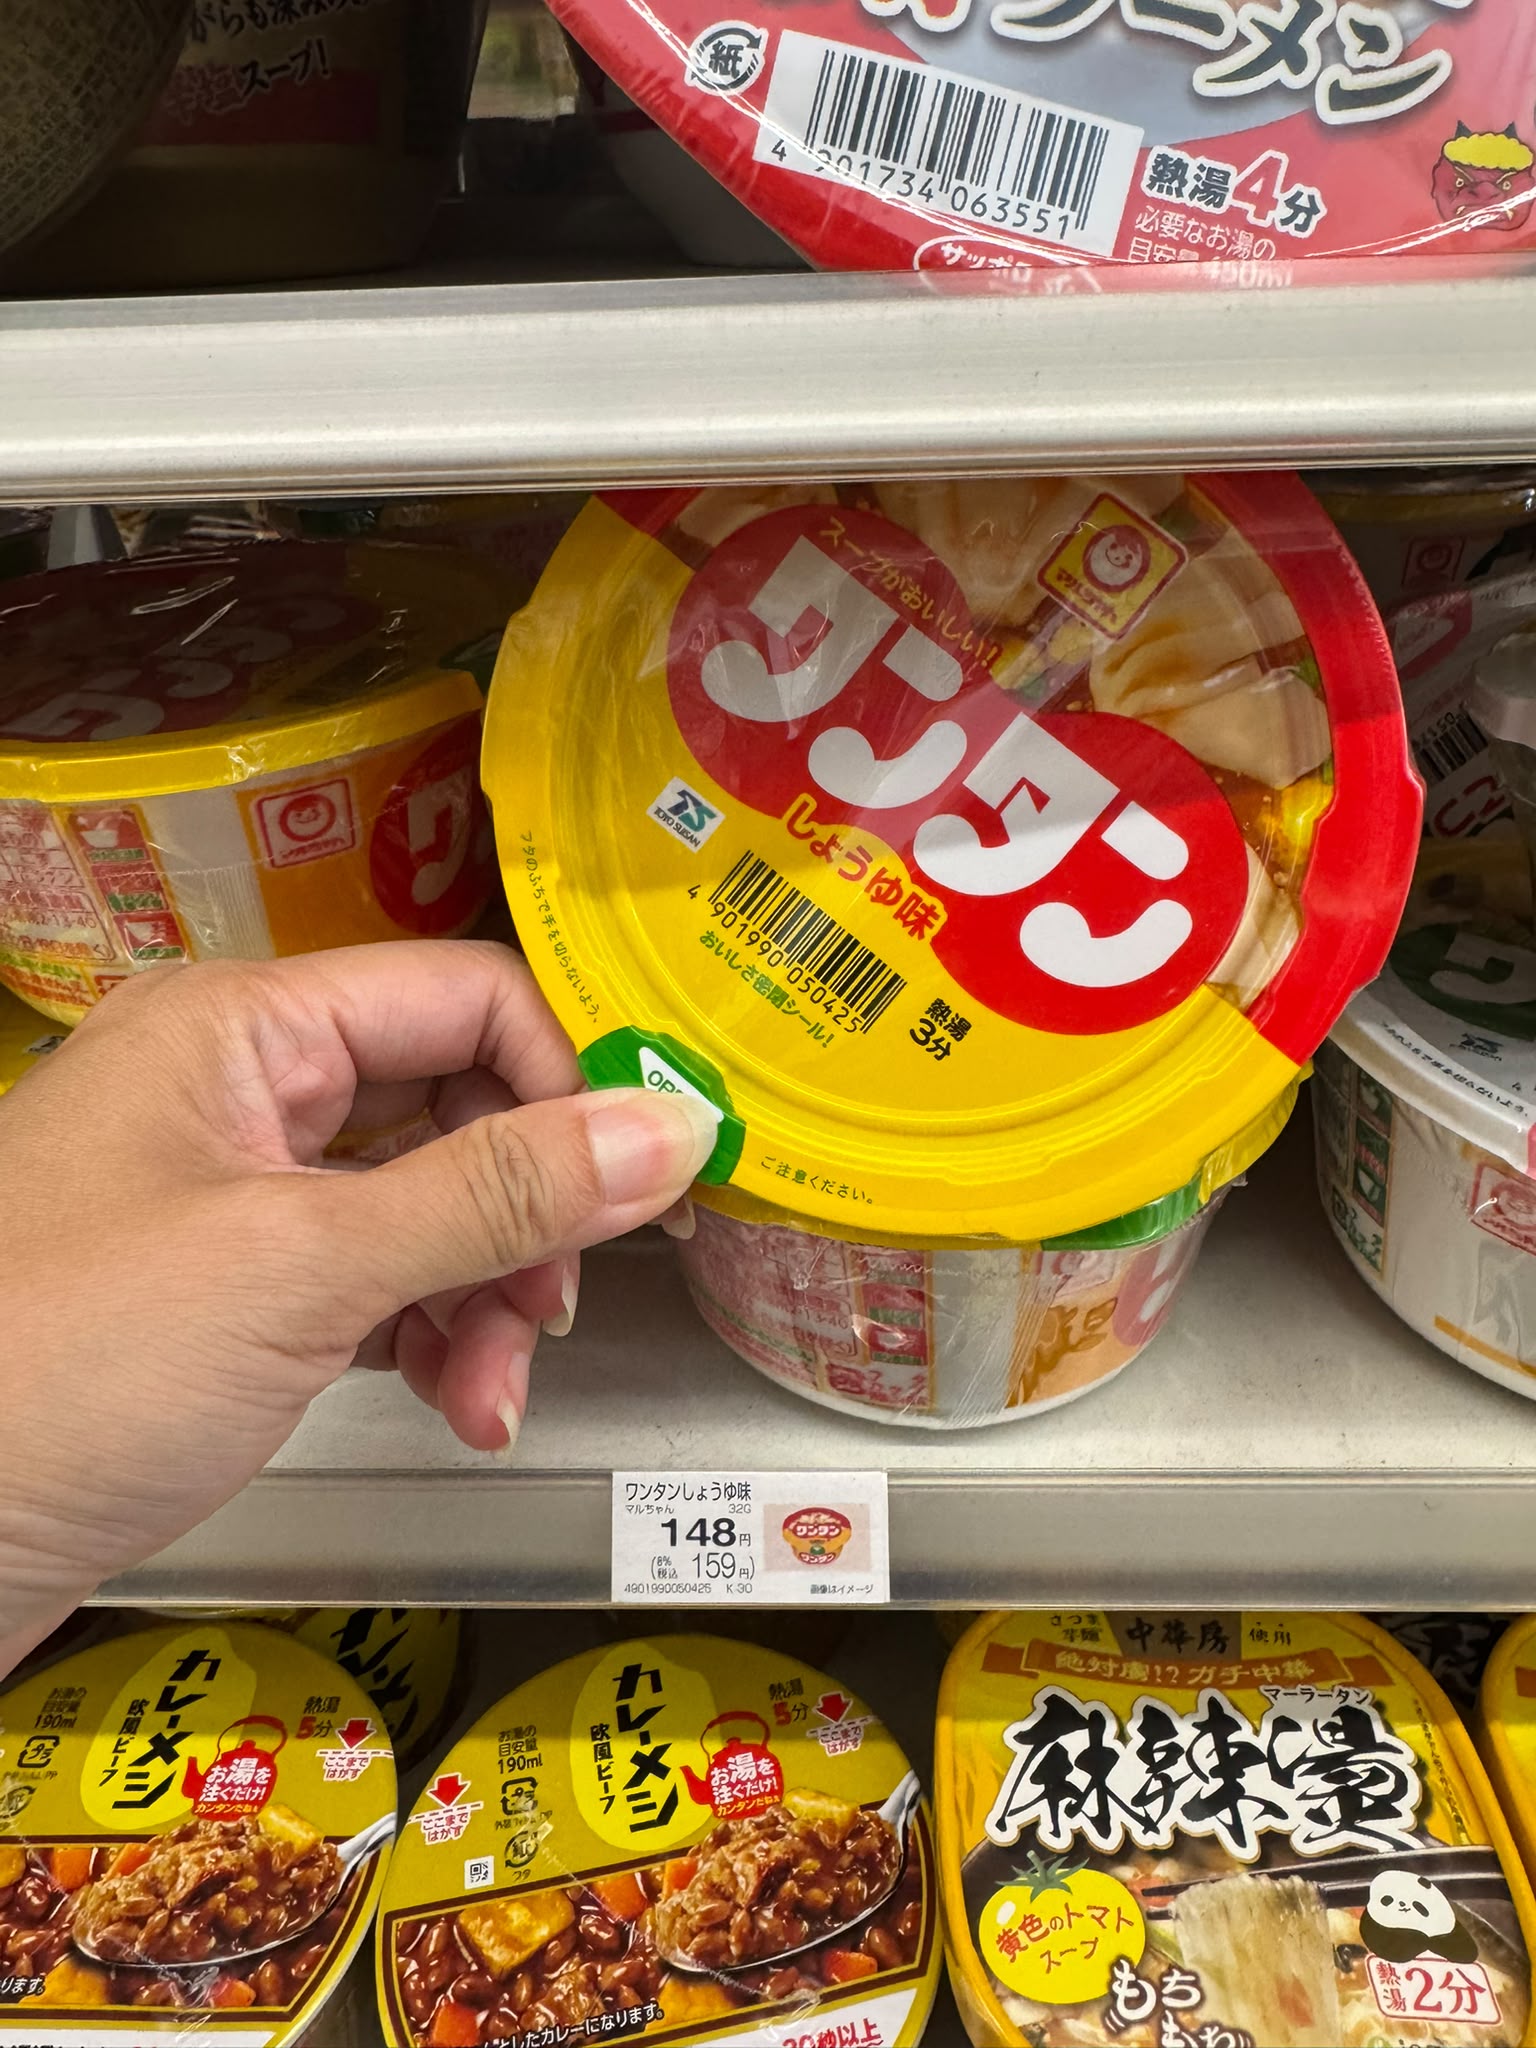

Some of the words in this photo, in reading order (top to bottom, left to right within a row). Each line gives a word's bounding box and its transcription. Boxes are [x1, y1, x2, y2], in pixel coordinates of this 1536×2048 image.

[707, 41, 745, 79] 紙
[771, 139, 788, 164] 4
[951, 184, 1071, 241] 063551
[1145, 151, 1323, 234] 熱湯4分
[1135, 203, 1277, 261] 必要なお湯の
[820, 516, 1003, 671] スープがおいしい!
[700, 534, 1194, 990] ワンタン
[654, 806, 675, 827] TOYO
[673, 822, 701, 848] SUISAN
[787, 800, 942, 943] しょうゆ味
[520, 831, 600, 1024] フタのふちで手を切らないよう、
[687, 884, 701, 902] 4
[710, 902, 785, 968] 901990
[787, 966, 863, 1034] 050425
[909, 1018, 952, 1061] 3分
[925, 998, 973, 1042] 熱湯
[760, 1155, 876, 1206] ご注意ください。
[624, 1504, 675, 1515] マルちゃん
[728, 1503, 752, 1514] 32G
[625, 1481, 752, 1502] ワンタンしょうゆ味
[1126, 1616, 1231, 1655] 中華房
[773, 1701, 809, 1726] 5分
[1262, 1686, 1371, 1705] マーラータン
[99, 1697, 150, 1787] 欧風ビーフ
[111, 1649, 222, 1810] カレーメシ
[295, 1715, 334, 1740] 5分
[498, 1738, 538, 1757] 目安量
[611, 1663, 679, 1833] カレーメシ
[205, 1757, 272, 1786] お湯を
[497, 1753, 544, 1774] 190ml
[590, 1724, 616, 1815] 欧風ビーフ
[711, 1752, 775, 1786] お湯を
[995, 1901, 1135, 1963] 黄色のトマト
[1039, 1936, 1100, 1975] スープ
[1110, 1958, 1202, 2020] もち
[1375, 1961, 1408, 2013] 熱湯
[1404, 1966, 1488, 2015] 2分
